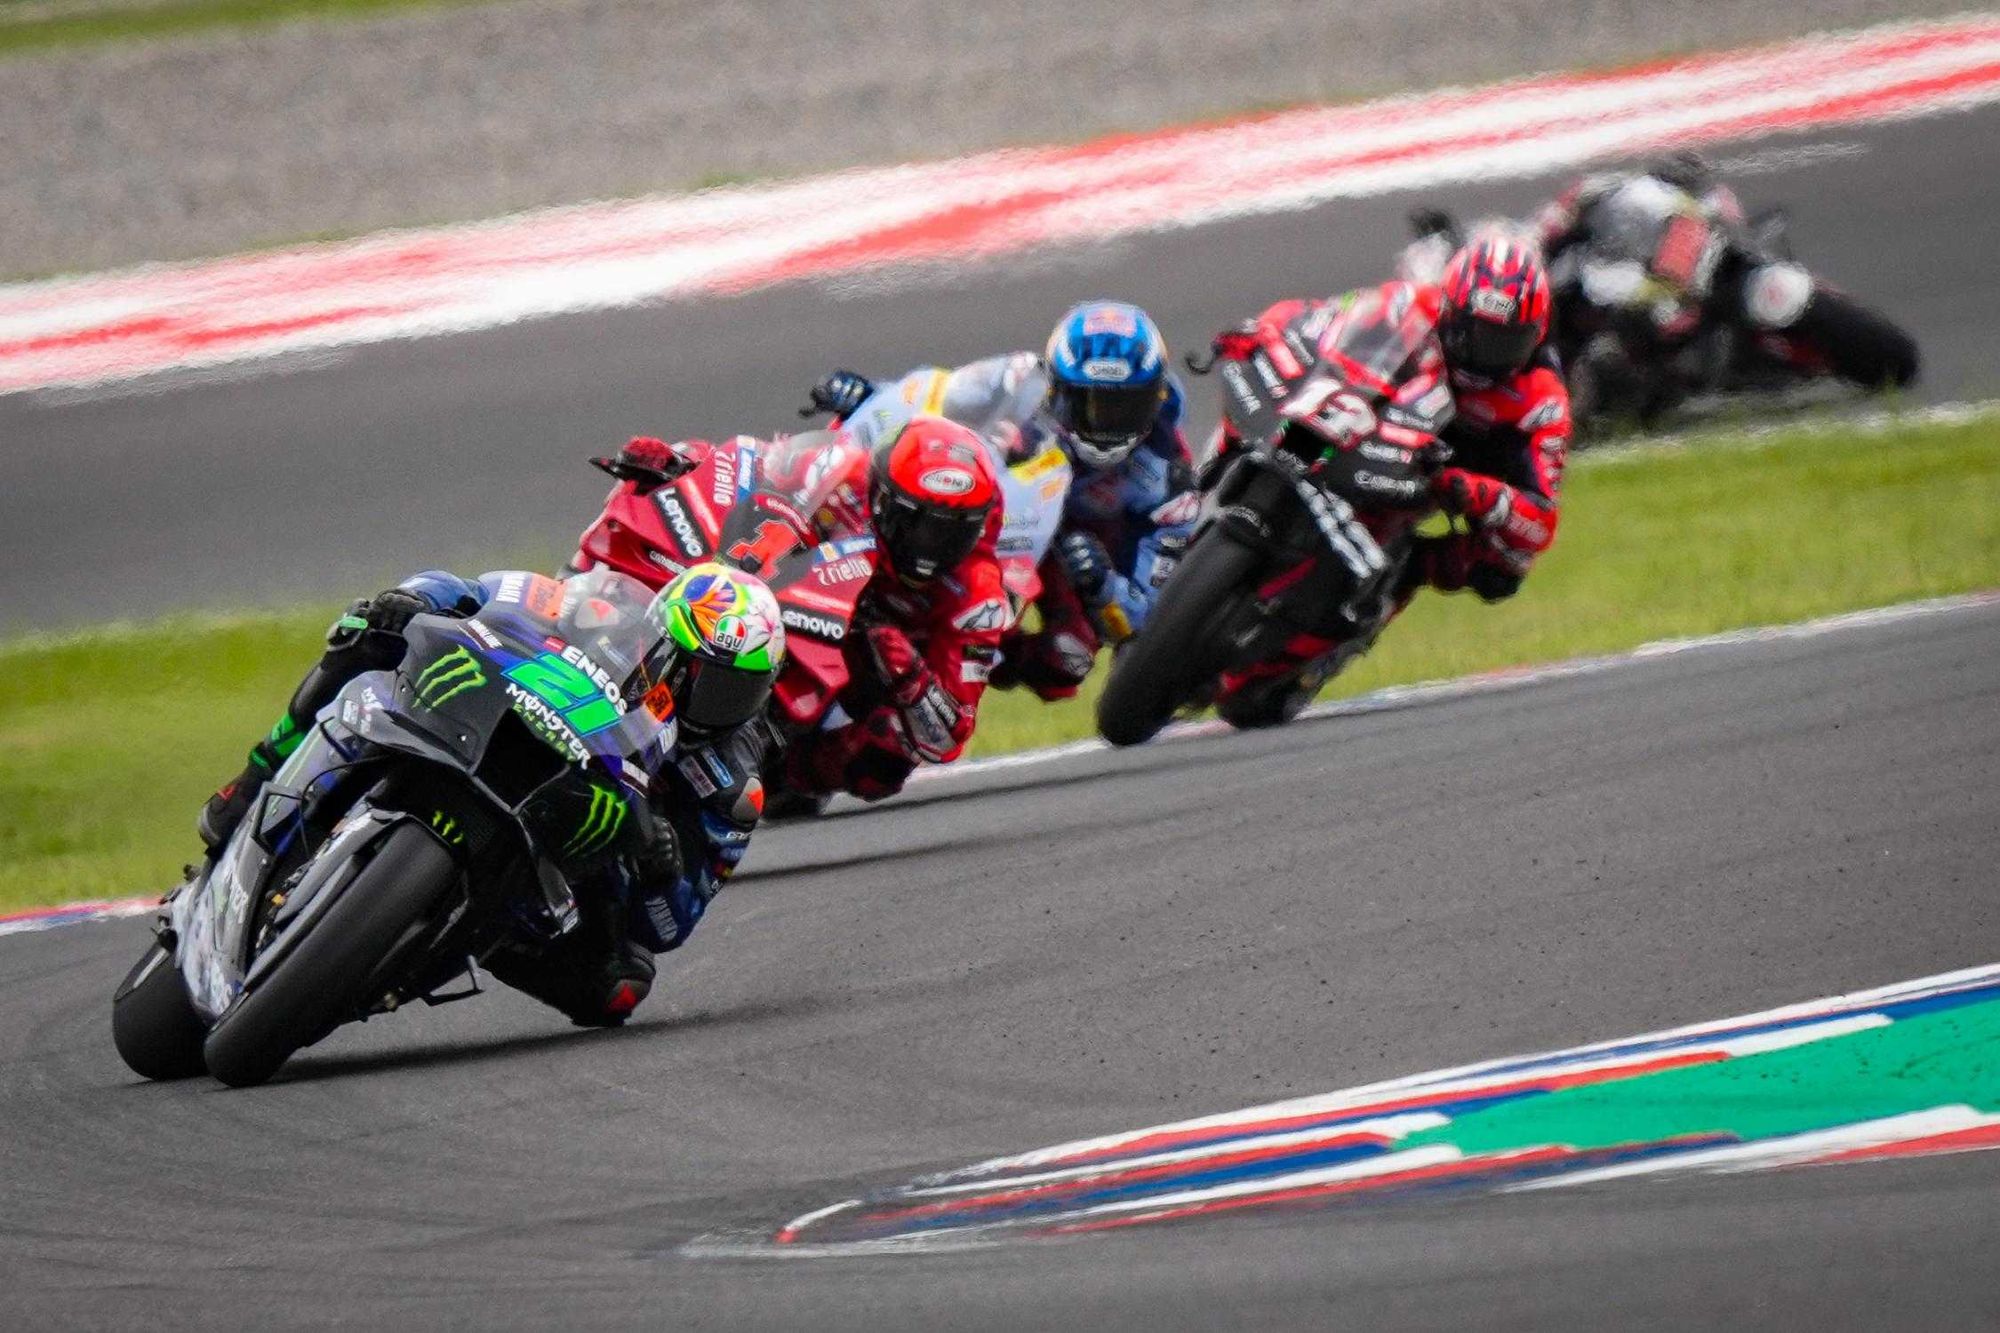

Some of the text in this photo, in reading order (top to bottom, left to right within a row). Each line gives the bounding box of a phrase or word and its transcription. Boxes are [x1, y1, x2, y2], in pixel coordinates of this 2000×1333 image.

[656, 487, 703, 557] Lenovo
[727, 519, 801, 582] 1
[782, 609, 844, 640] enovo
[561, 646, 628, 716] ENEOS
[506, 683, 592, 770] MONSTER
